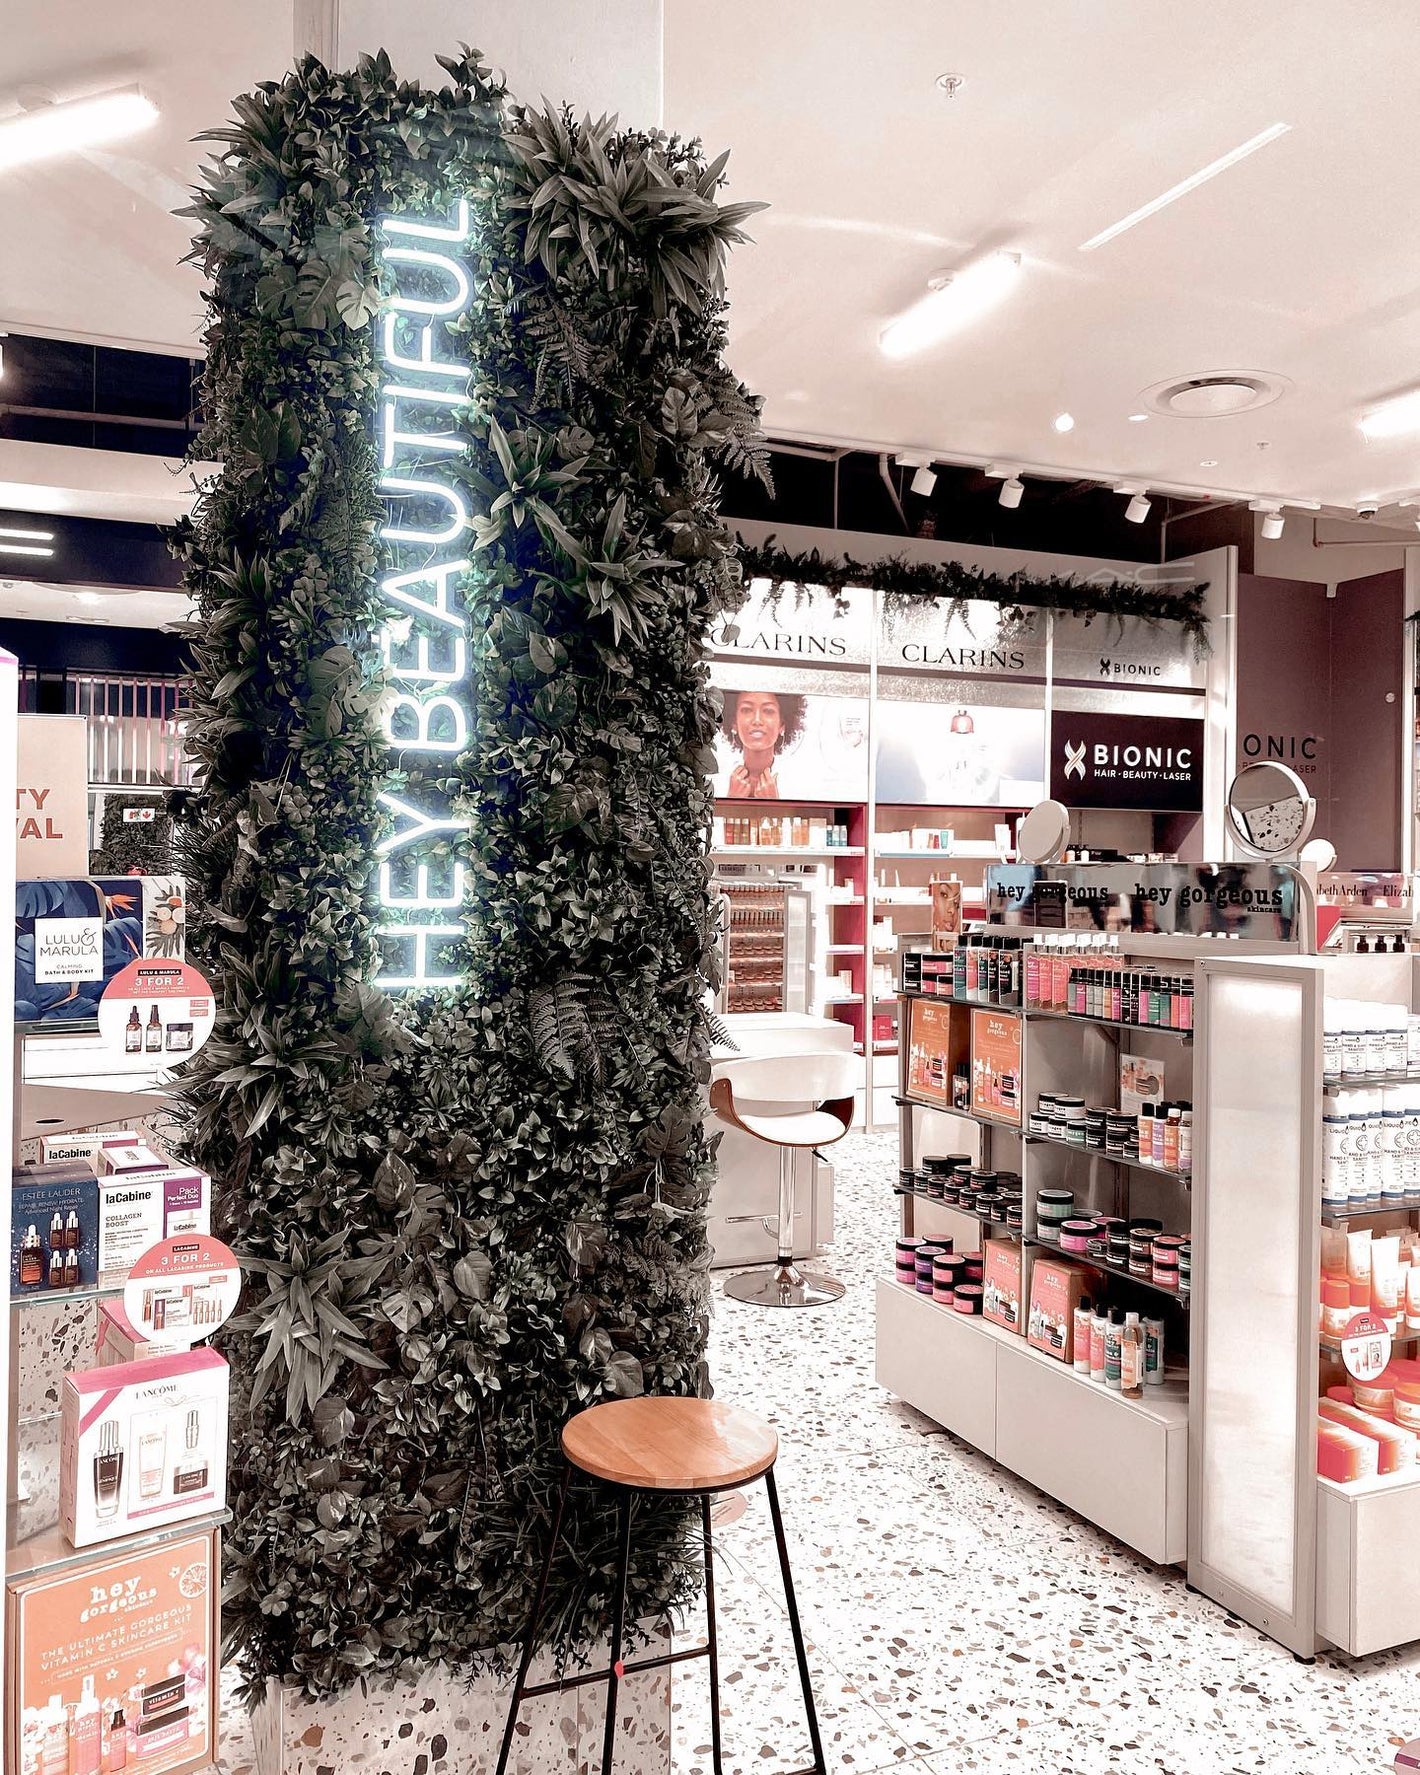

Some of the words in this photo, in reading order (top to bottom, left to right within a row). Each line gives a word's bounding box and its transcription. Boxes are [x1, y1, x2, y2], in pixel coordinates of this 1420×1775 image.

[379, 198, 473, 754] BEAUTIFUL
[902, 643, 1025, 670] CLARINS
[1114, 663, 1161, 677] BIONIC
[1094, 744, 1192, 769] BIONIC
[1094, 769, 1117, 778] HAIR
[1123, 770, 1158, 780] BEAUTY
[1163, 772, 1192, 782] LASER
[1291, 764, 1317, 774] ASER
[16, 817, 63, 839] AL
[374, 788, 473, 989] HEY
[997, 882, 1026, 902] hey
[1032, 884, 1110, 904] gorgeous
[1340, 884, 1368, 898] Arden
[1134, 883, 1173, 906] hey
[1180, 885, 1284, 910] gorgeous
[40, 945, 99, 957] MARULA
[135, 977, 142, 986] 3
[147, 977, 172, 986] FOR
[176, 977, 184, 986] 2
[49, 1148, 92, 1160] laCabine
[48, 1187, 81, 1198] LAUDER
[106, 1190, 151, 1205] laCabine
[179, 1186, 199, 1196] Pack
[105, 1212, 143, 1222] COLLAGEN
[105, 1220, 130, 1229] BOOST
[161, 1256, 169, 1266] 3
[173, 1254, 199, 1265] FOR
[202, 1252, 211, 1262] 2
[90, 1576, 142, 1604] hey
[80, 1587, 158, 1623] gorgeous
[40, 1646, 64, 1661] THE
[69, 1625, 126, 1651] ULTIMATE
[130, 1603, 192, 1630] GORGEOUS
[41, 1647, 94, 1671] VITAMIN
[98, 1643, 106, 1652] C
[110, 1621, 170, 1649] SKINCARE
[174, 1613, 192, 1625] KIT
